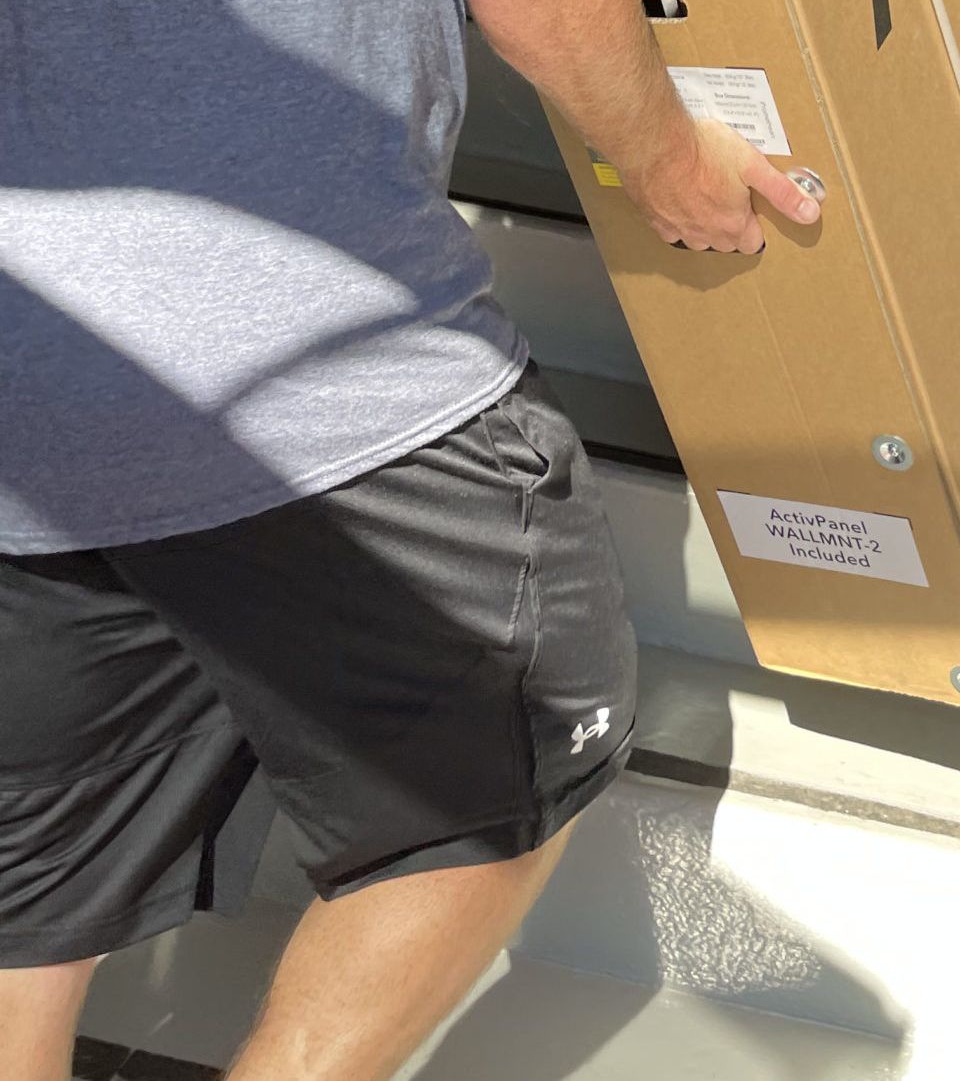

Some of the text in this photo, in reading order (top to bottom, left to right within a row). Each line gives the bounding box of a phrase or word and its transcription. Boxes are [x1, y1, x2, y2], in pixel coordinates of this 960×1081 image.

[769, 508, 868, 535] ActivPanel
[765, 523, 882, 553] WALLMNT-2
[789, 543, 871, 568] Included
